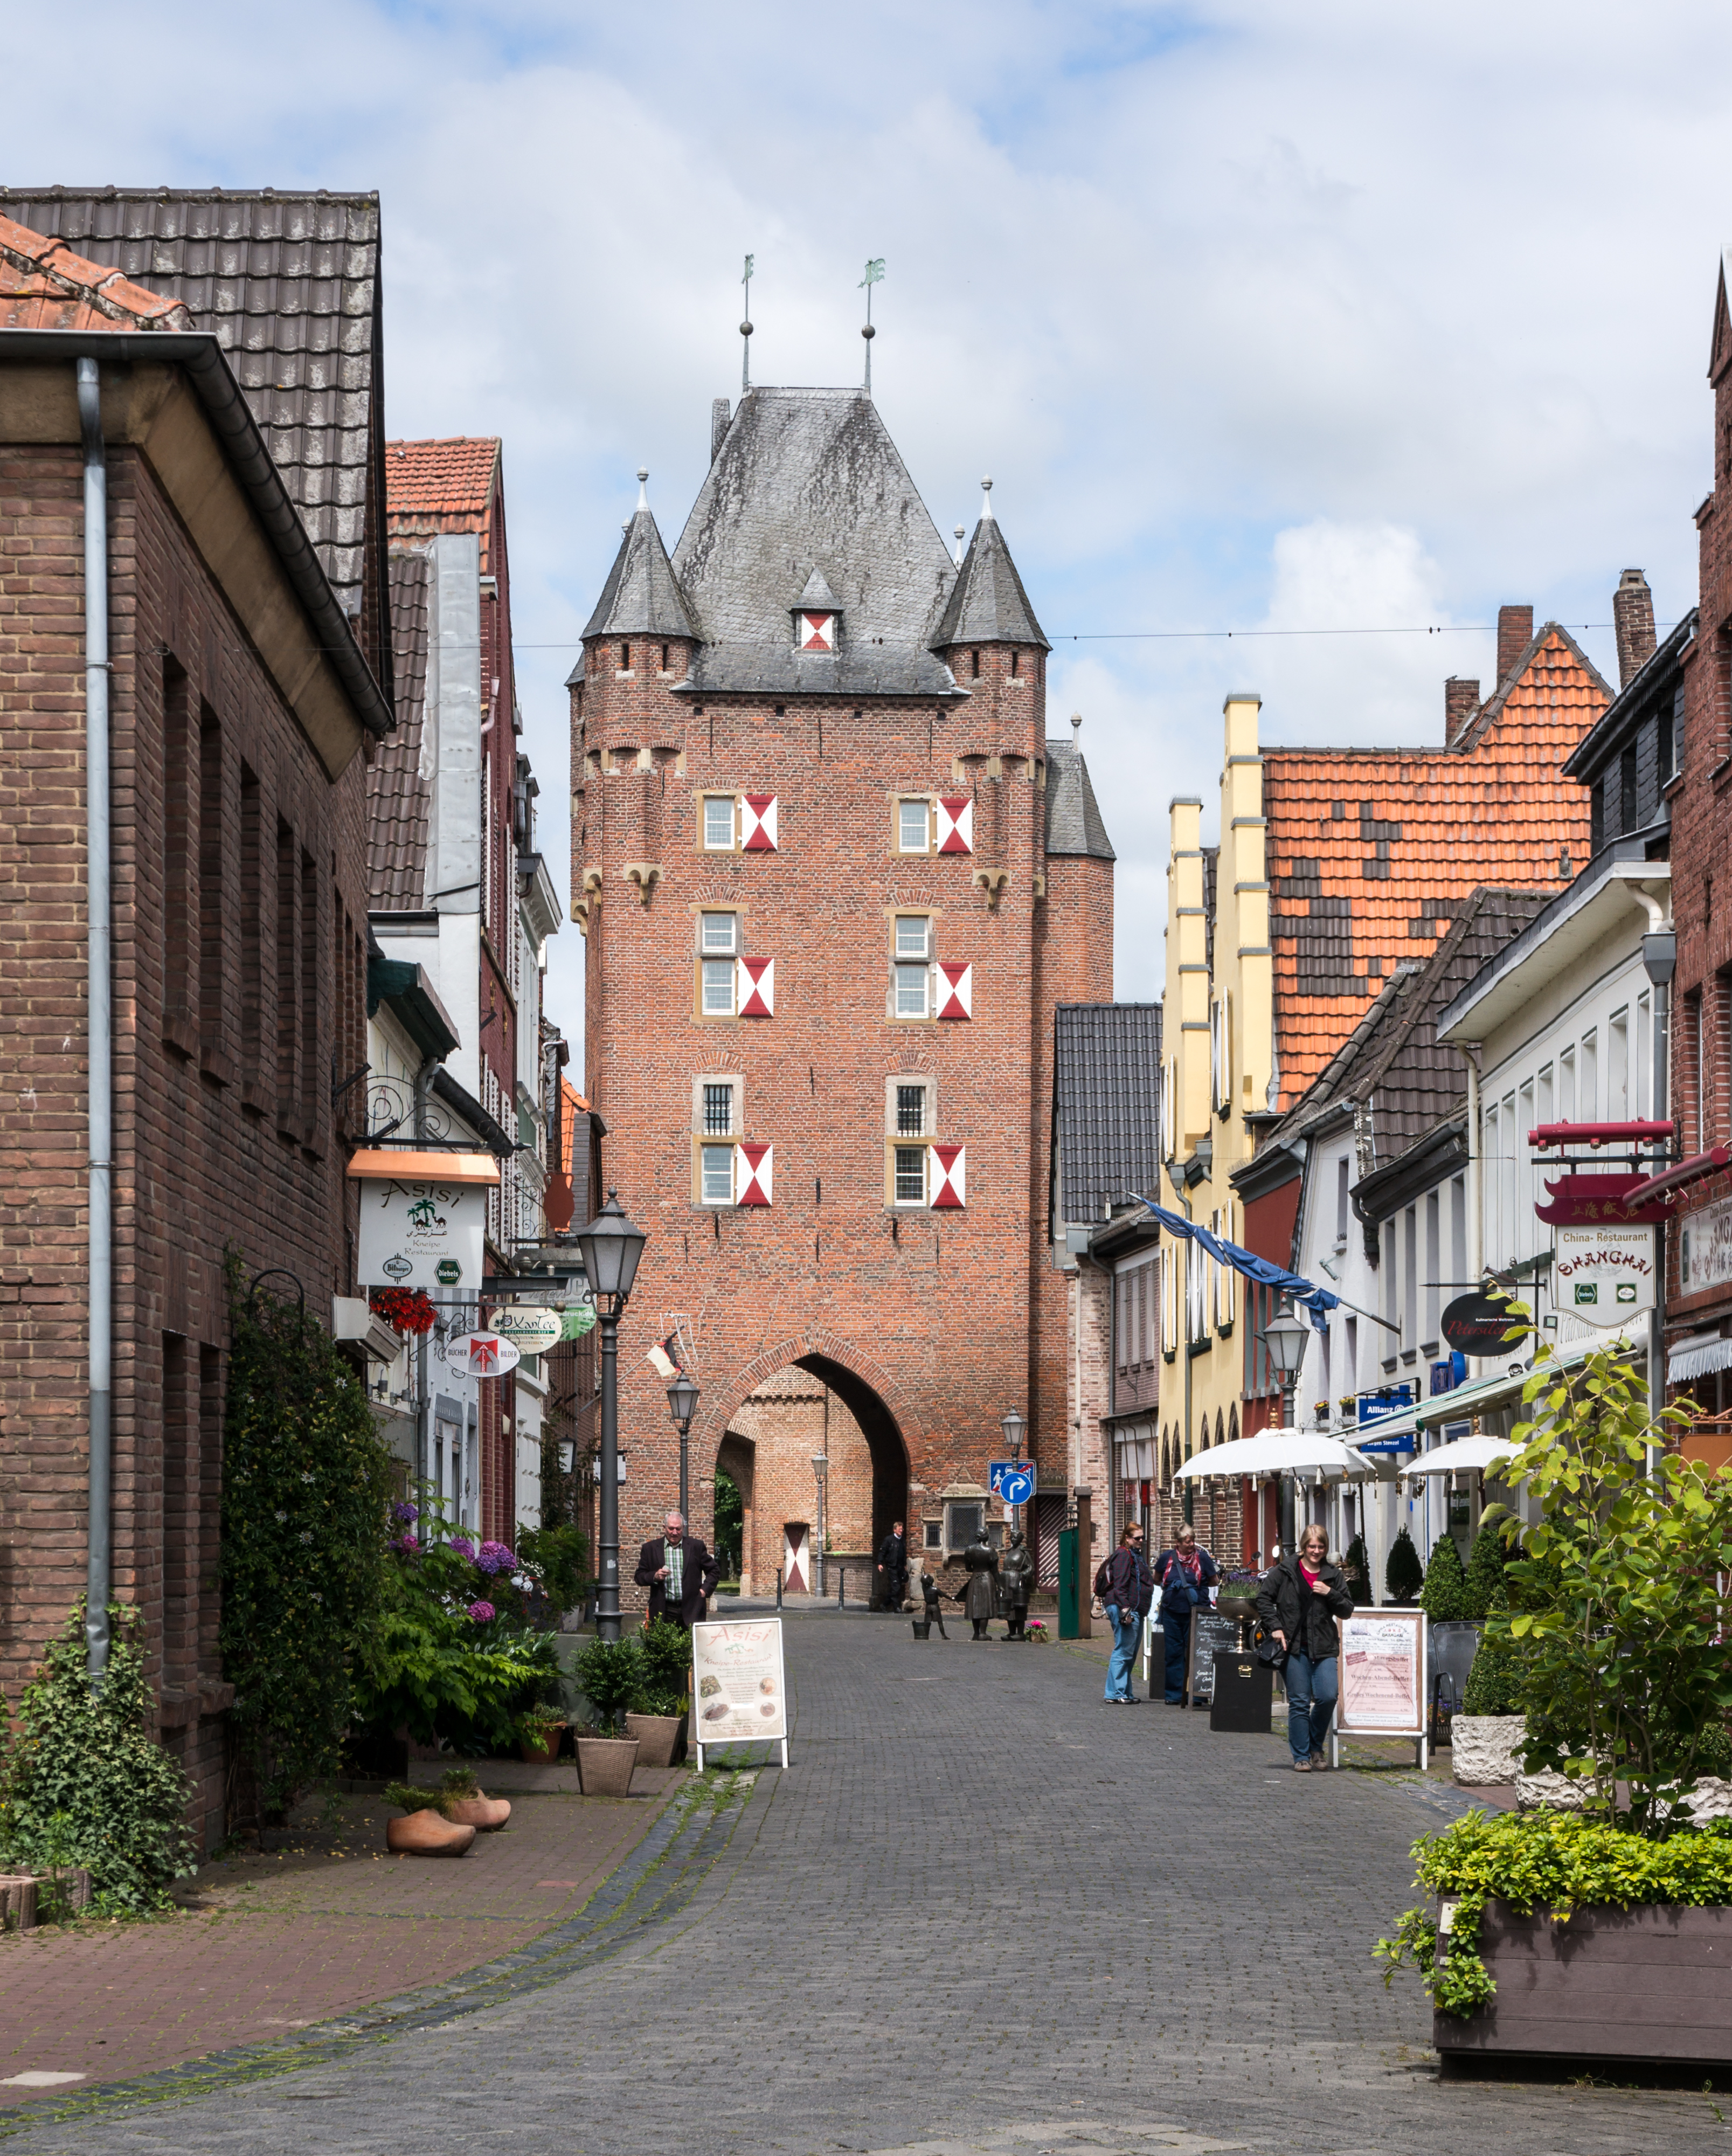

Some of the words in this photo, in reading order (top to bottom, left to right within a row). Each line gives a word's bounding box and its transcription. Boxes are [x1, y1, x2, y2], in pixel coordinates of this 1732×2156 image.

[380, 1178, 464, 1208] Asisi
[1563, 1233, 1594, 1242] China-
[1597, 1232, 1647, 1242] Restaurant
[413, 1239, 441, 1249] Kneipe
[404, 1248, 449, 1256] Restaurant
[387, 1263, 409, 1272] Bitburger
[1558, 1251, 1653, 1276] SHANGHAI
[448, 1348, 467, 1356] BÜCHER
[1367, 1406, 1394, 1414] Allianz
[706, 1626, 772, 1647] Asisi
[704, 1653, 773, 1666] Kneipe-Restaurant
